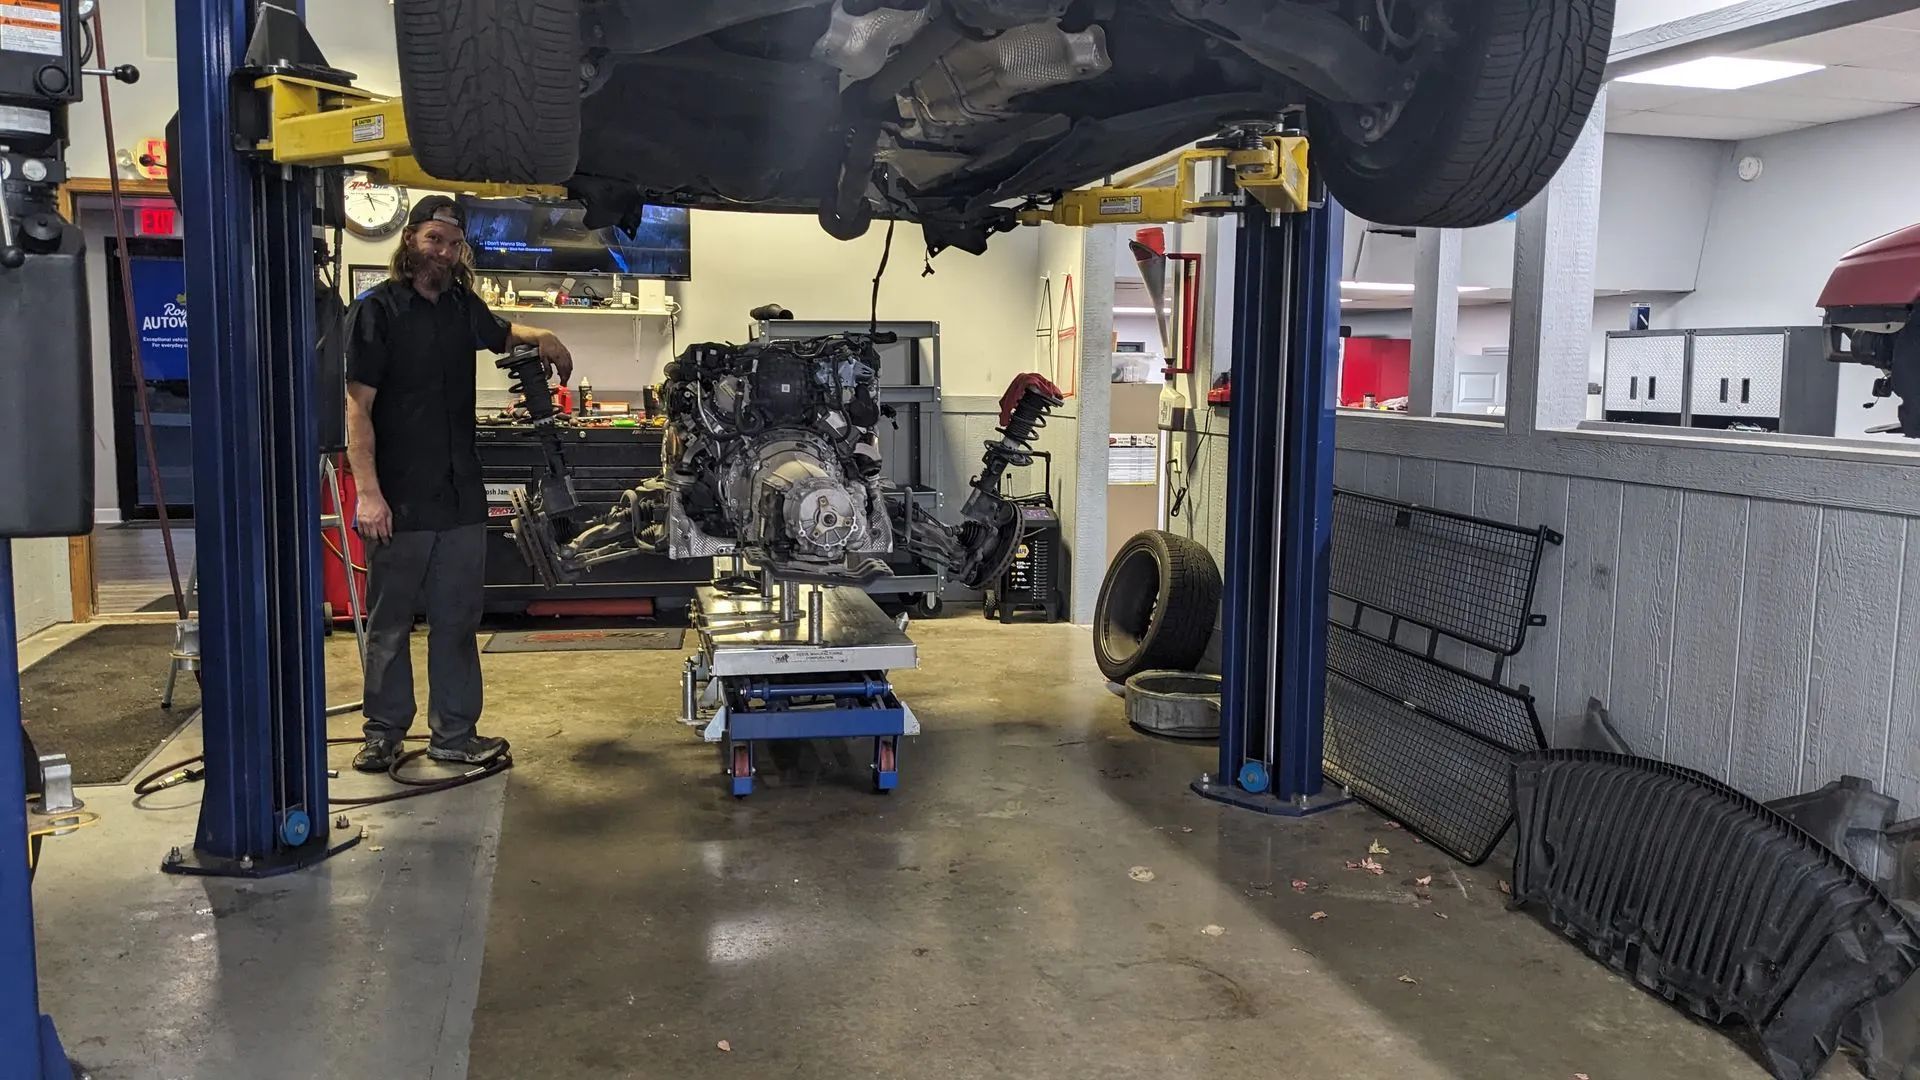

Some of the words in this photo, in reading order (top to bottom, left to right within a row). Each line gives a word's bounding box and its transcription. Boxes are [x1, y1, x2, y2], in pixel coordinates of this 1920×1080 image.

[163, 302, 187, 321] Roy
[142, 316, 188, 331] AUTOW
[489, 507, 516, 515] AMSO
